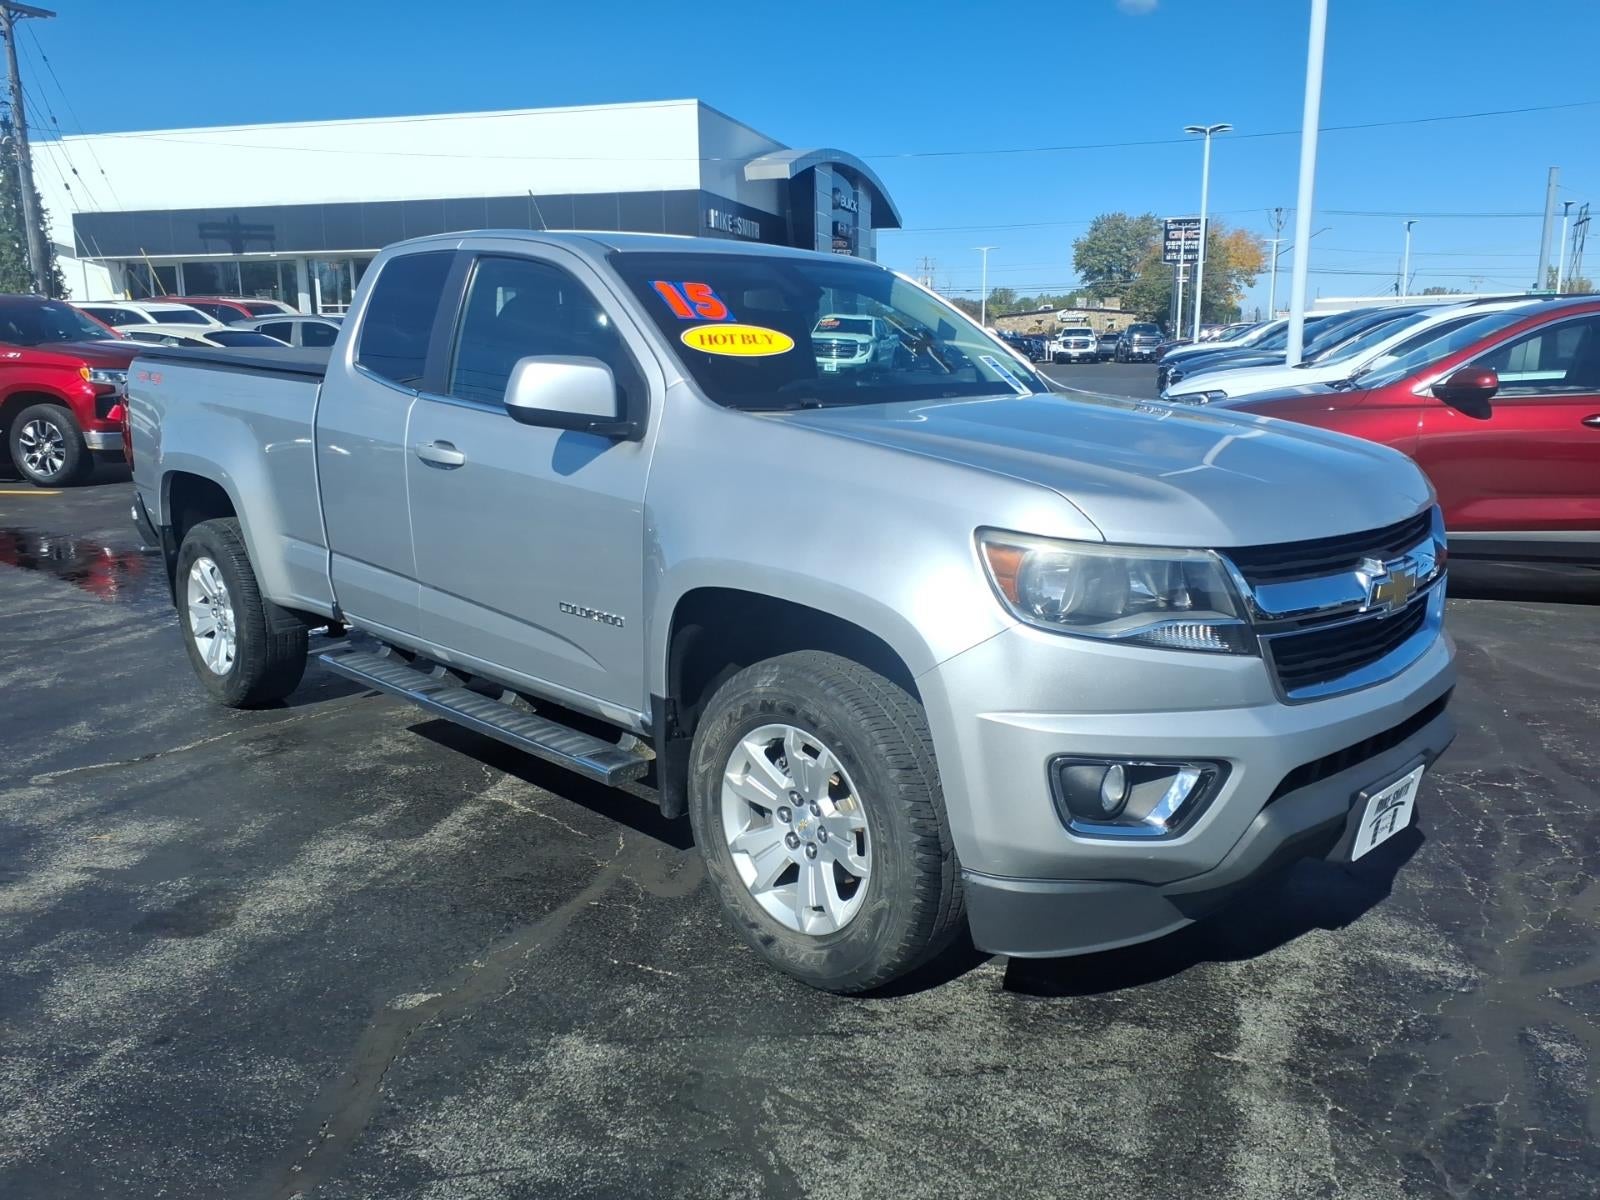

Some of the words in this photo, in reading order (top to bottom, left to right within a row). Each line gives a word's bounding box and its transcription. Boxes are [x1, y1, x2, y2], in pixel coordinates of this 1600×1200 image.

[653, 280, 729, 319] 15
[699, 334, 738, 347] HOT
[742, 333, 774, 346] BUY
